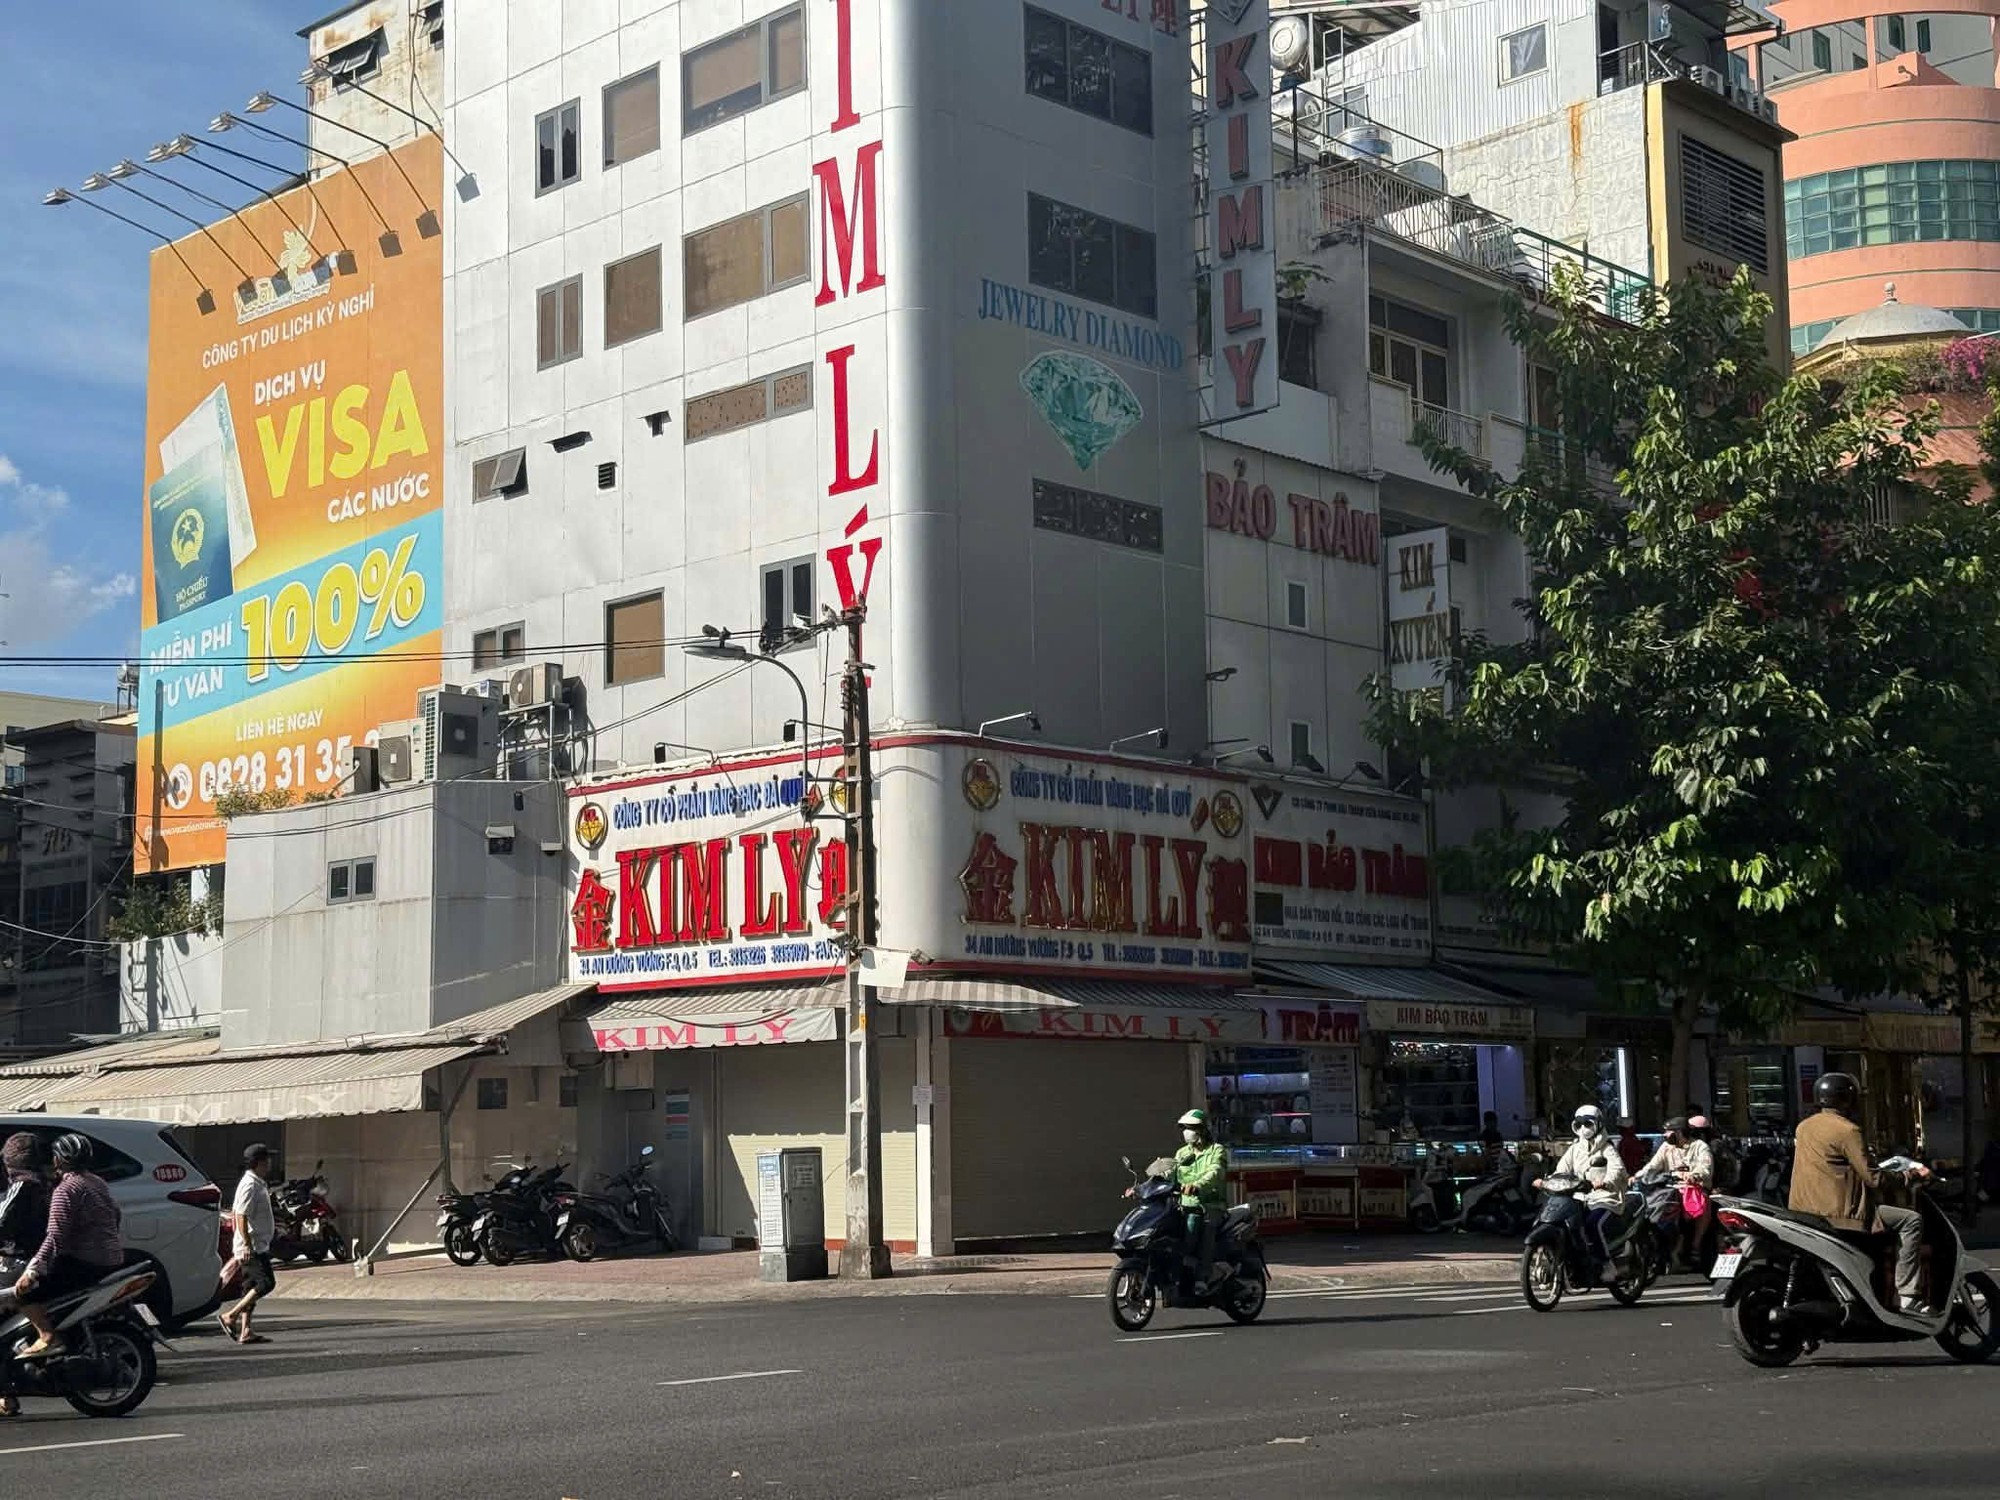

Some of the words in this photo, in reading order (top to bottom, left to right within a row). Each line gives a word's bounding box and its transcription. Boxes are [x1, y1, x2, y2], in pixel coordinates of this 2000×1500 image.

[1214, 33, 1264, 258] KIM
[202, 340, 239, 369] CÔNG
[240, 332, 259, 356] TY
[261, 326, 279, 348] DU
[282, 316, 313, 343] LỊCH
[977, 277, 1081, 343] JEWELRY
[1085, 309, 1185, 370] DIAMOND
[1222, 267, 1266, 408] LY
[254, 370, 296, 406] DỊCH
[299, 359, 327, 391] VỤ
[254, 368, 429, 499] VISA
[327, 486, 366, 524] CÁC
[370, 470, 431, 512] NƯỚC
[1205, 456, 1277, 541] BẢO
[1287, 491, 1381, 566] TRÂM
[1398, 542, 1436, 592] KIM
[200, 612, 233, 657] PHÍ
[241, 532, 426, 685] 100%
[266, 714, 285, 739] HỆ
[287, 709, 323, 732] NGAY
[200, 751, 267, 803] 0828
[274, 744, 306, 790] 31
[613, 796, 642, 830] CÔNG
[643, 799, 660, 827] TY
[709, 783, 738, 816] VÀNG
[614, 837, 729, 947] KIM
[1018, 821, 1139, 934] KIM
[592, 957, 605, 974] AN
[593, 1022, 699, 1050] KIM
[1037, 1008, 1147, 1035] KIM
